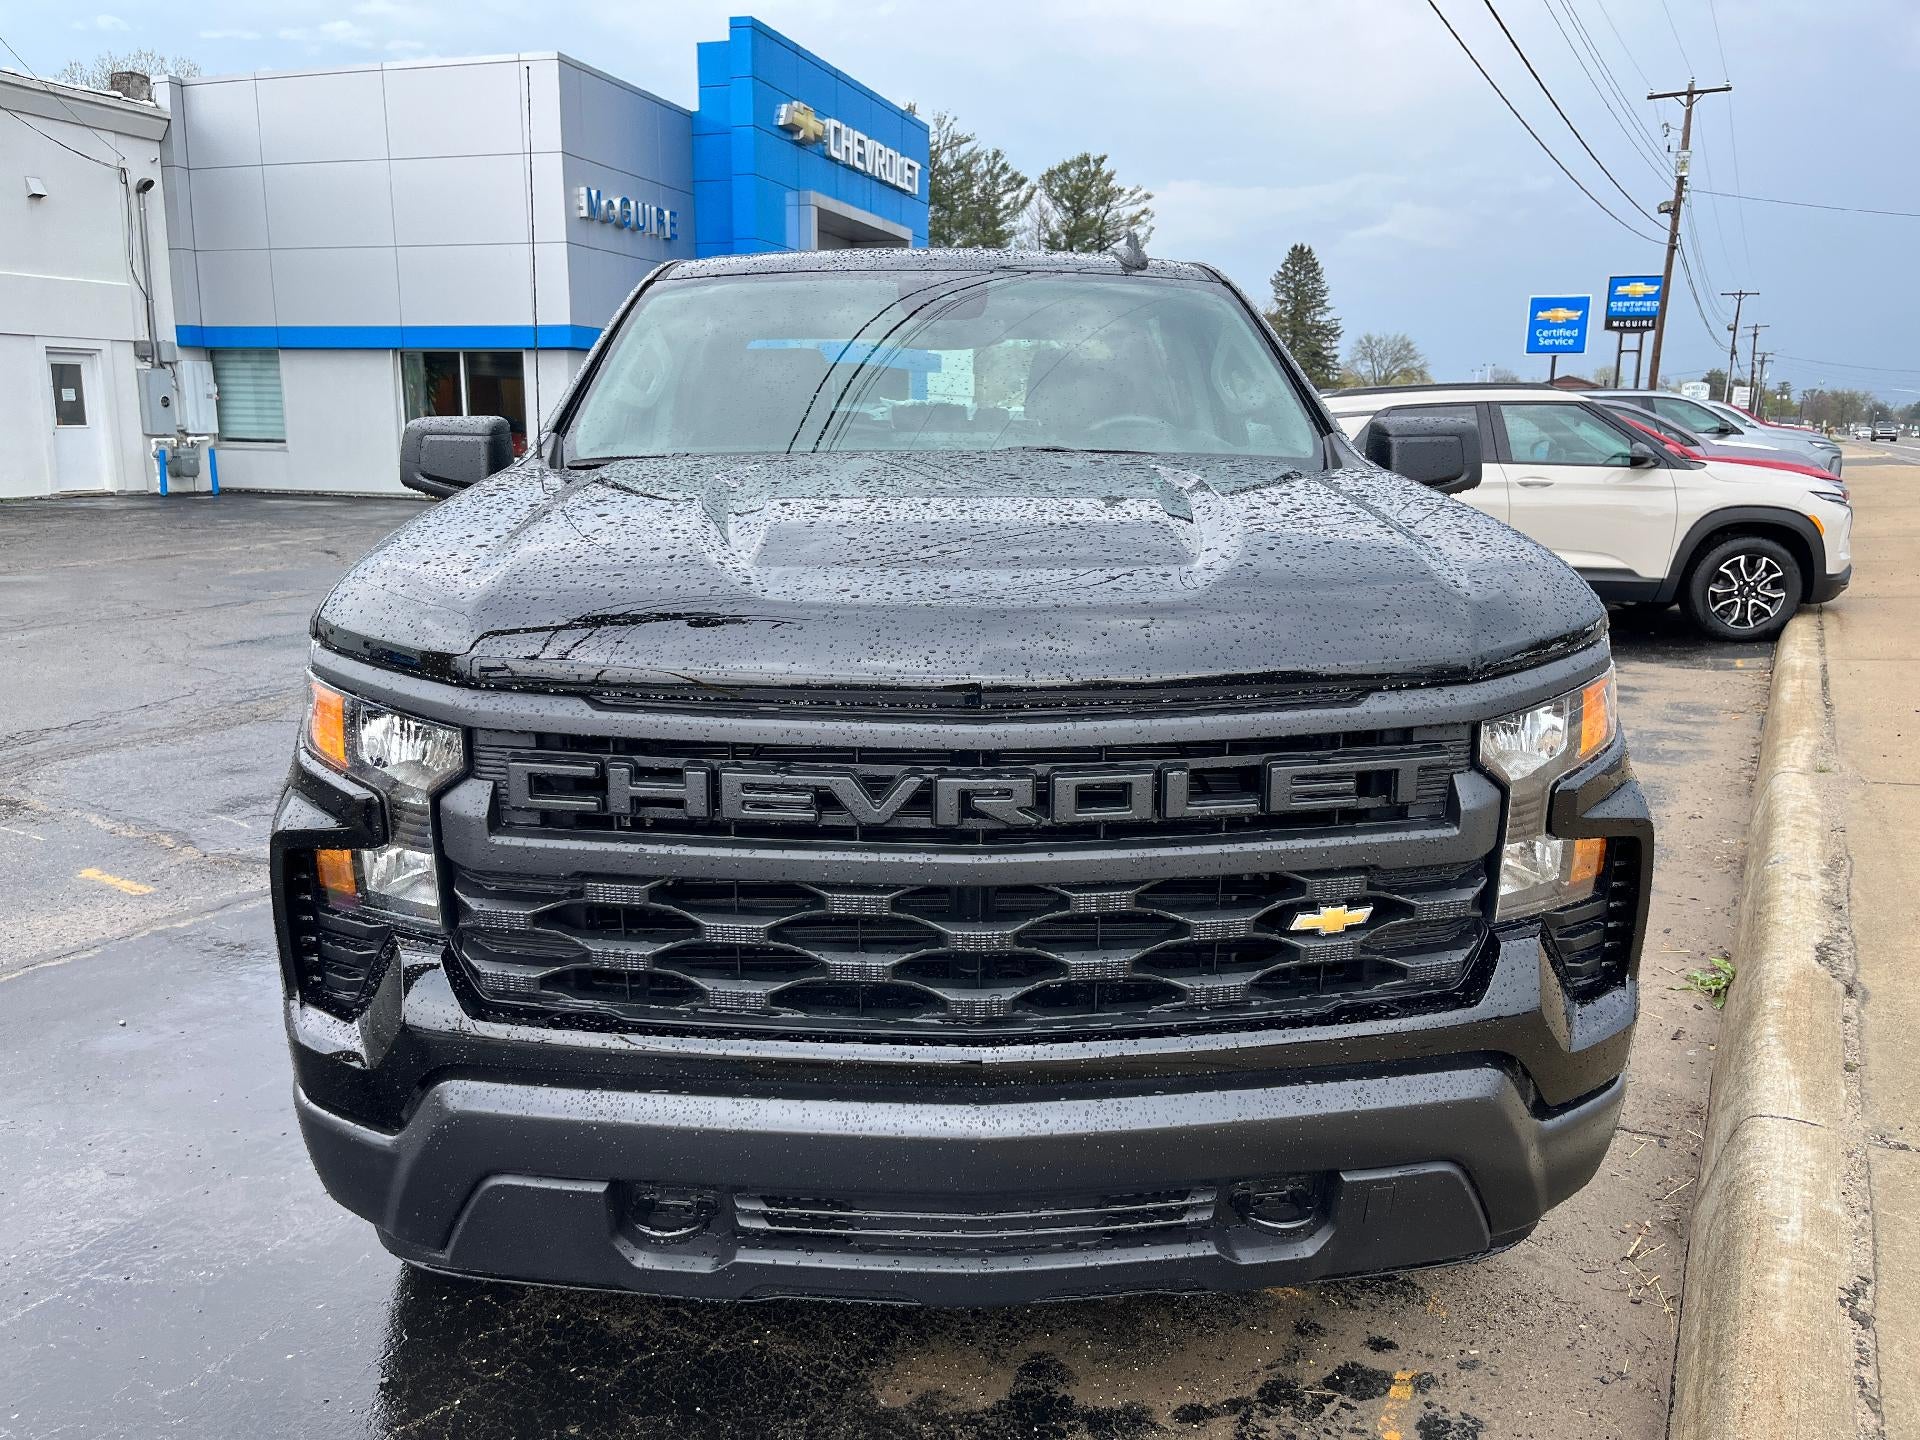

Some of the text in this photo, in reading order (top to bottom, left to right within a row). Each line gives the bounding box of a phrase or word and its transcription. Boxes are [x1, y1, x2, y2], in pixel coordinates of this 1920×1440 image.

[825, 118, 921, 196] CHEVROLET
[579, 186, 678, 240] McGUIRE
[1536, 328, 1578, 337] Certified
[1538, 337, 1575, 345] Service
[507, 752, 1450, 826] CHEVROLET
